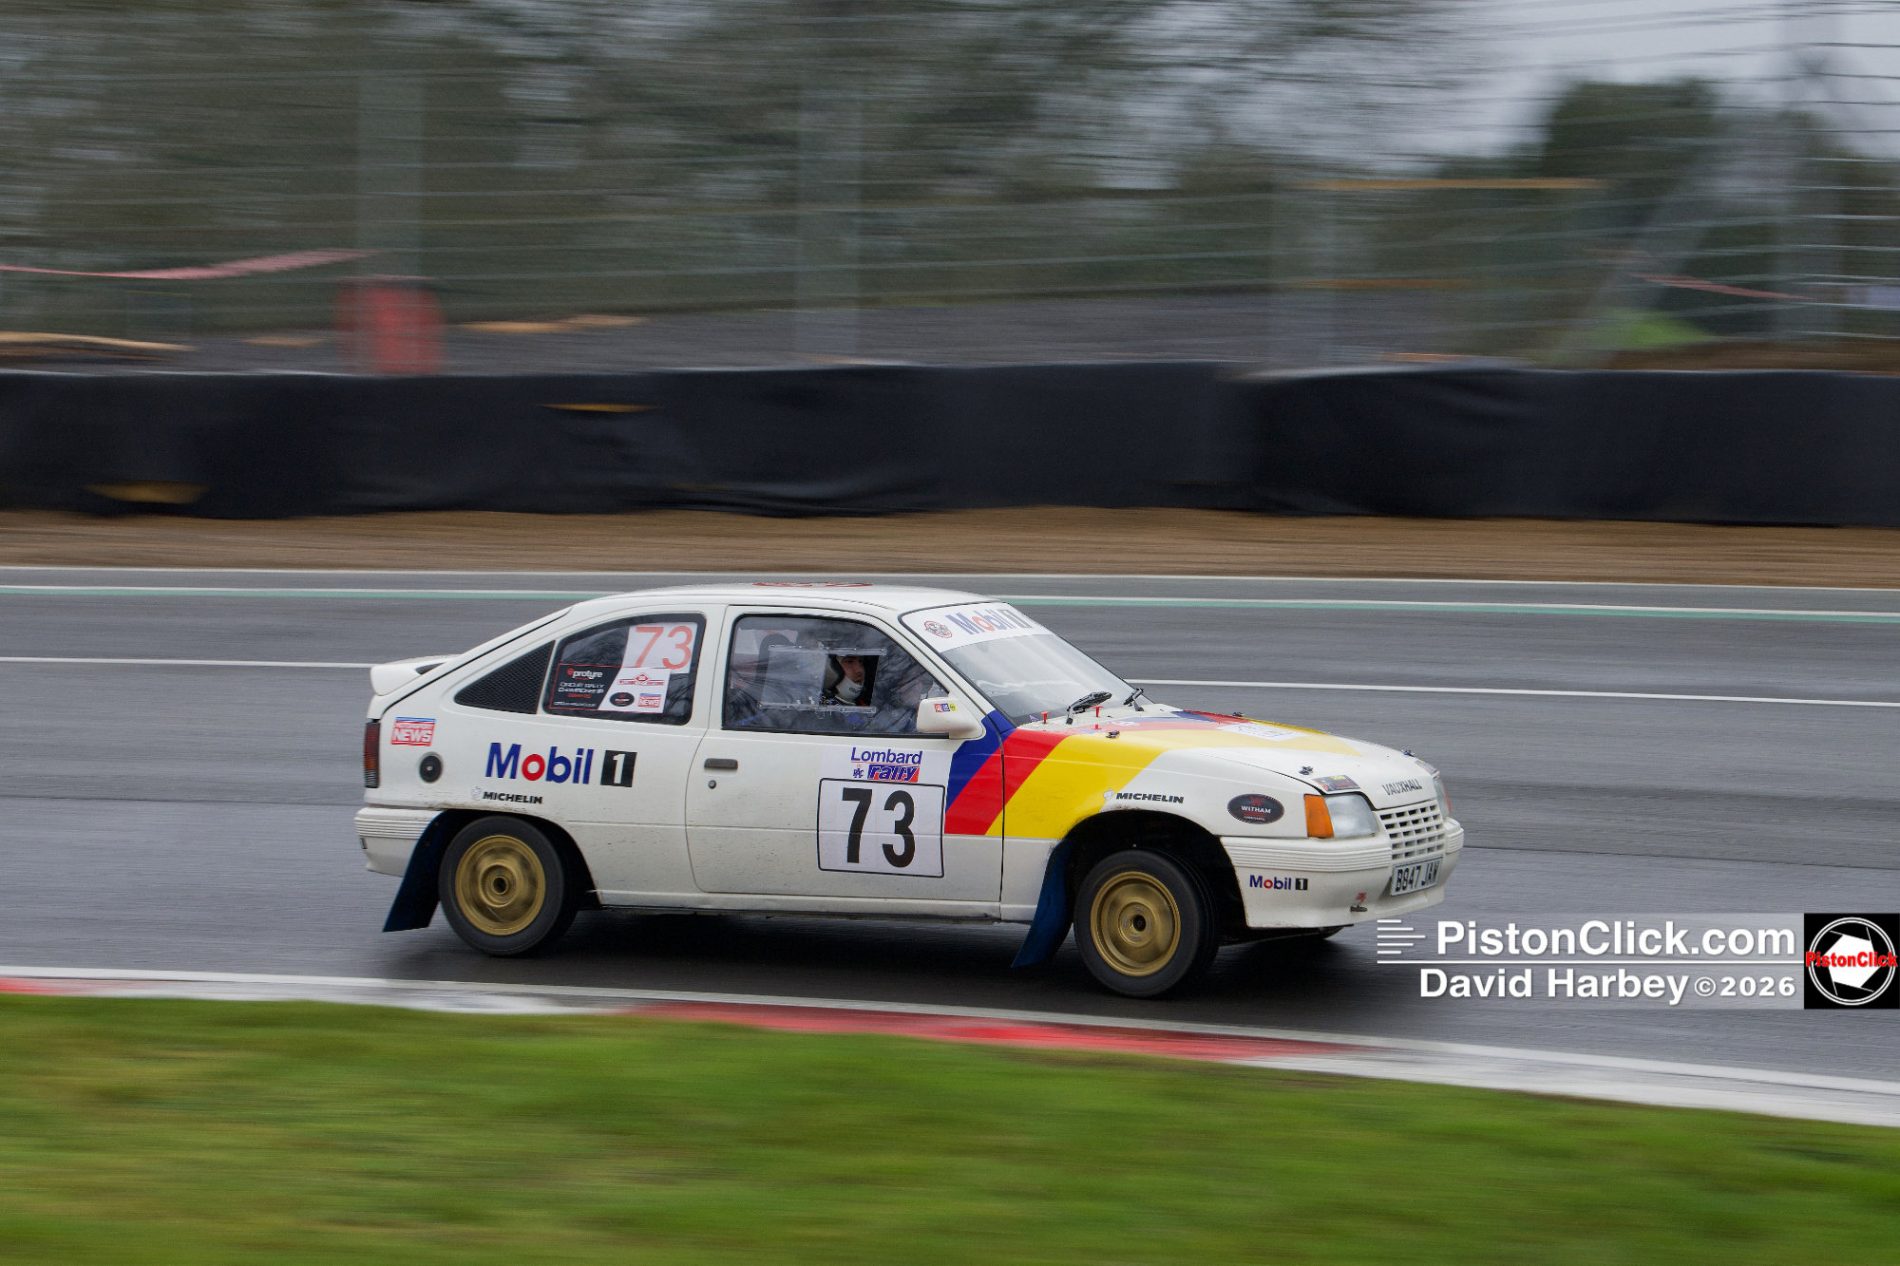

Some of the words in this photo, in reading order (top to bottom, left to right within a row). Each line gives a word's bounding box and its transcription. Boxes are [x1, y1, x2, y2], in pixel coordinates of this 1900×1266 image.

[945, 609, 1017, 634] Mobil
[635, 625, 693, 669] 73
[572, 670, 603, 680] protyre
[395, 728, 432, 743] NEWS
[485, 742, 594, 784] Mobil
[851, 747, 923, 764] Lombard
[869, 765, 918, 782] rally
[1382, 779, 1422, 796] VAUXHALL
[483, 791, 543, 804] MICHELIN
[1116, 792, 1184, 804] MICHELIN
[1241, 805, 1271, 814] WITHAM
[842, 787, 915, 868] 73
[1250, 874, 1291, 891] Mobil
[1395, 865, 1421, 892] B847
